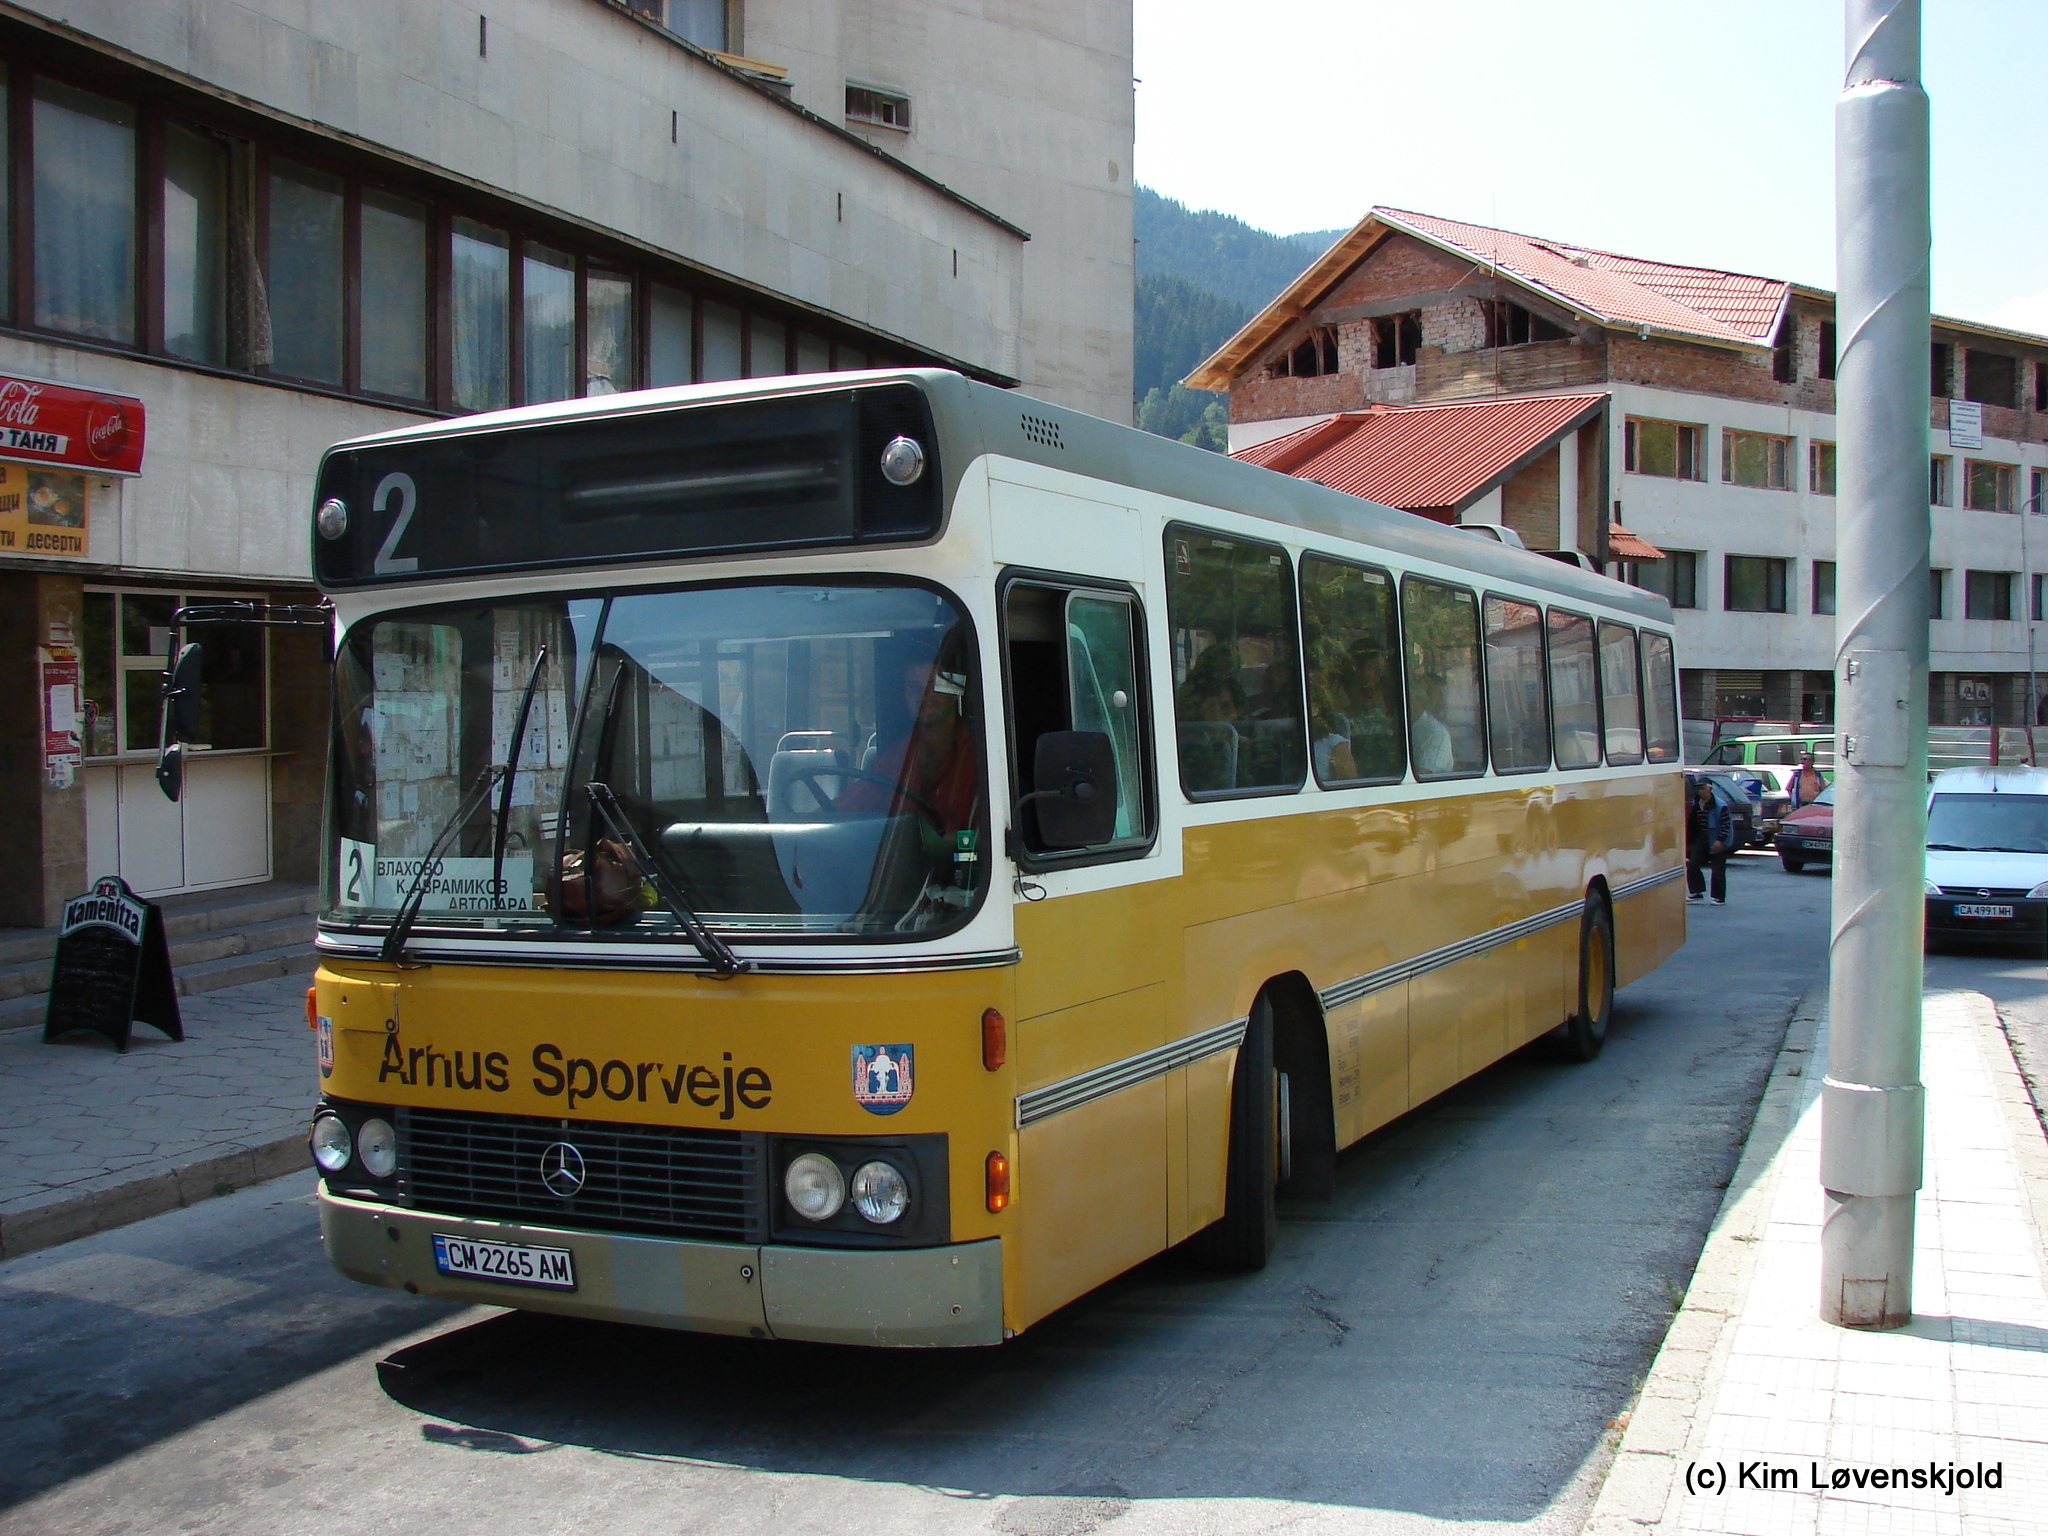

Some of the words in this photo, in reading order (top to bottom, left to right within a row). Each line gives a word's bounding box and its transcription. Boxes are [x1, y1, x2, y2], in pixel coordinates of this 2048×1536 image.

[9, 429, 58, 452] ТАНЯ
[373, 472, 419, 575] 2
[27, 532, 82, 552] десерти
[347, 848, 362, 902] 2
[377, 861, 444, 876] ВЛАХОВО
[66, 899, 140, 936] Kamenitza
[1960, 905, 1973, 915] CA
[532, 1043, 772, 1120] Sporveje
[439, 1256, 449, 1266] BG
[448, 1243, 478, 1270] CM
[479, 1247, 534, 1277] 2265
[539, 1253, 569, 1282] AM
